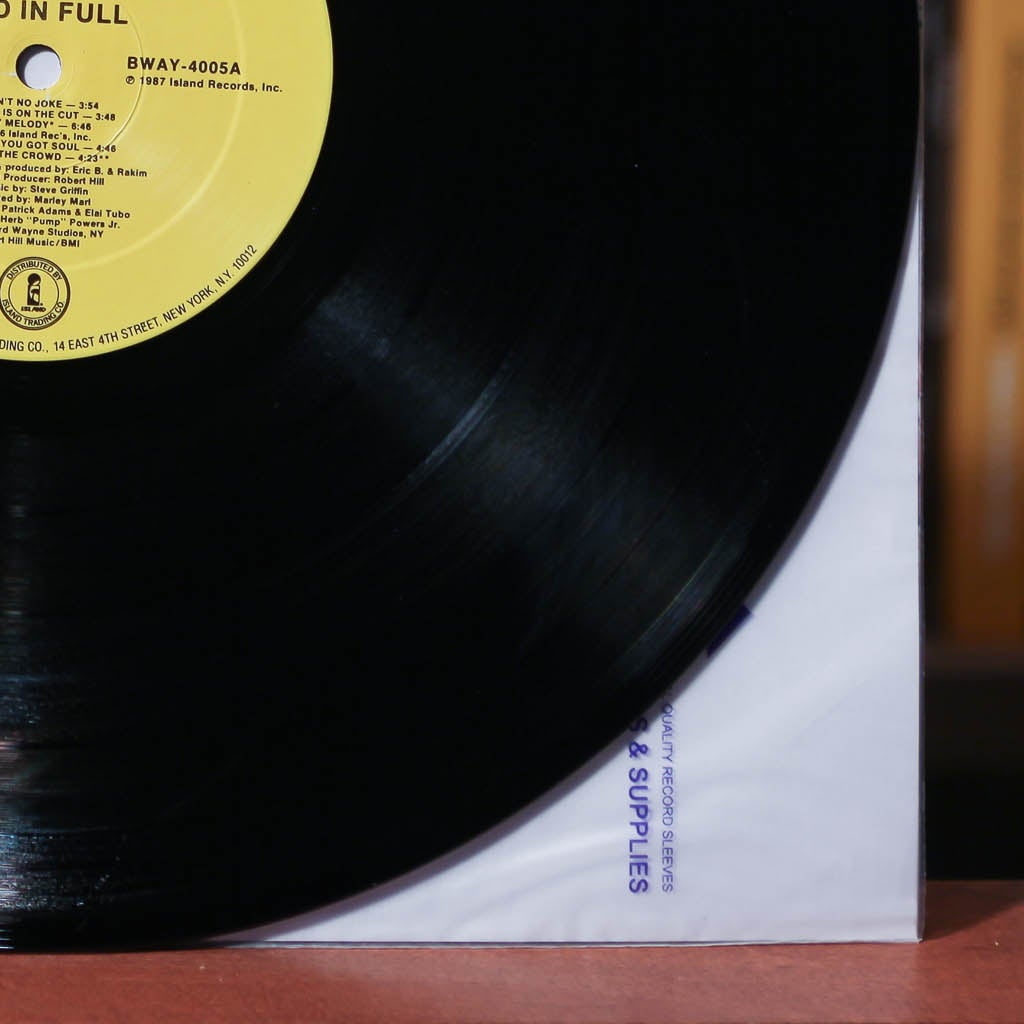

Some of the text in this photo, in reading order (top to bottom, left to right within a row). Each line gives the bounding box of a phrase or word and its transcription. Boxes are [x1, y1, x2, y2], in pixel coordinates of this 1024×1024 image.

[20, 0, 47, 21] IN
[59, 1, 128, 24] FULL
[127, 56, 240, 75] BWAY-4005A
[139, 74, 165, 87] 1987
[169, 76, 203, 89] Island
[208, 78, 257, 93] Records,
[262, 81, 282, 93] Inc.
[16, 97, 31, 108] NO
[34, 98, 62, 109] JOKE
[78, 100, 98, 110] 3:54
[2, 107, 12, 117] IS
[15, 107, 30, 118] ON
[34, 108, 54, 119] THE
[57, 109, 79, 120] CUT
[95, 111, 115, 122] 3:48
[71, 121, 91, 131] 6:46
[8, 129, 38, 140] Island
[72, 132, 92, 142] Inc.
[0, 138, 22, 149] YOU
[26, 139, 48, 150] GOT
[51, 140, 79, 152] SOUL
[96, 142, 116, 153] 4:46
[21, 149, 61, 161] CROWD
[5, 162, 51, 173] produced
[54, 163, 69, 176] by:
[72, 164, 90, 175] Eric
[94, 165, 103, 176] B.
[107, 166, 113, 176] &
[117, 166, 147, 177] Rakim
[3, 171, 50, 184] Producer:
[53, 174, 86, 185] Robert
[89, 175, 104, 186] Hill
[12, 183, 26, 195] by:
[30, 183, 56, 194] Steve
[59, 184, 88, 196] Griffin
[16, 193, 30, 206] by:
[34, 194, 66, 207] Marley
[1, 203, 34, 215] Patrick
[38, 205, 71, 216] Adams
[74, 207, 81, 217] &
[105, 208, 130, 219] Tubo
[0, 214, 23, 225] Herb
[26, 215, 66, 228] "Pump"
[69, 217, 104, 229] Powers
[108, 219, 120, 229] Jr.
[12, 224, 44, 237] Wayne
[47, 226, 86, 239] Studios,
[89, 228, 103, 239] NY
[7, 235, 22, 245] Hill
[26, 236, 79, 248] Music/BMI
[6, 260, 63, 281] DISTRIBUTED BY
[54, 341, 65, 351] 14
[68, 336, 95, 351] EAST
[98, 330, 119, 345] 4TH
[162, 303, 187, 323] NEW
[186, 285, 218, 308] YORK,
[232, 244, 257, 270] 10012
[2, 298, 23, 323] ISLAND
[23, 312, 57, 326] TRADING
[629, 740, 649, 758] &
[661, 703, 673, 893] QUALITY RECORD SLEEVES
[628, 767, 649, 894] SUPPLIES
